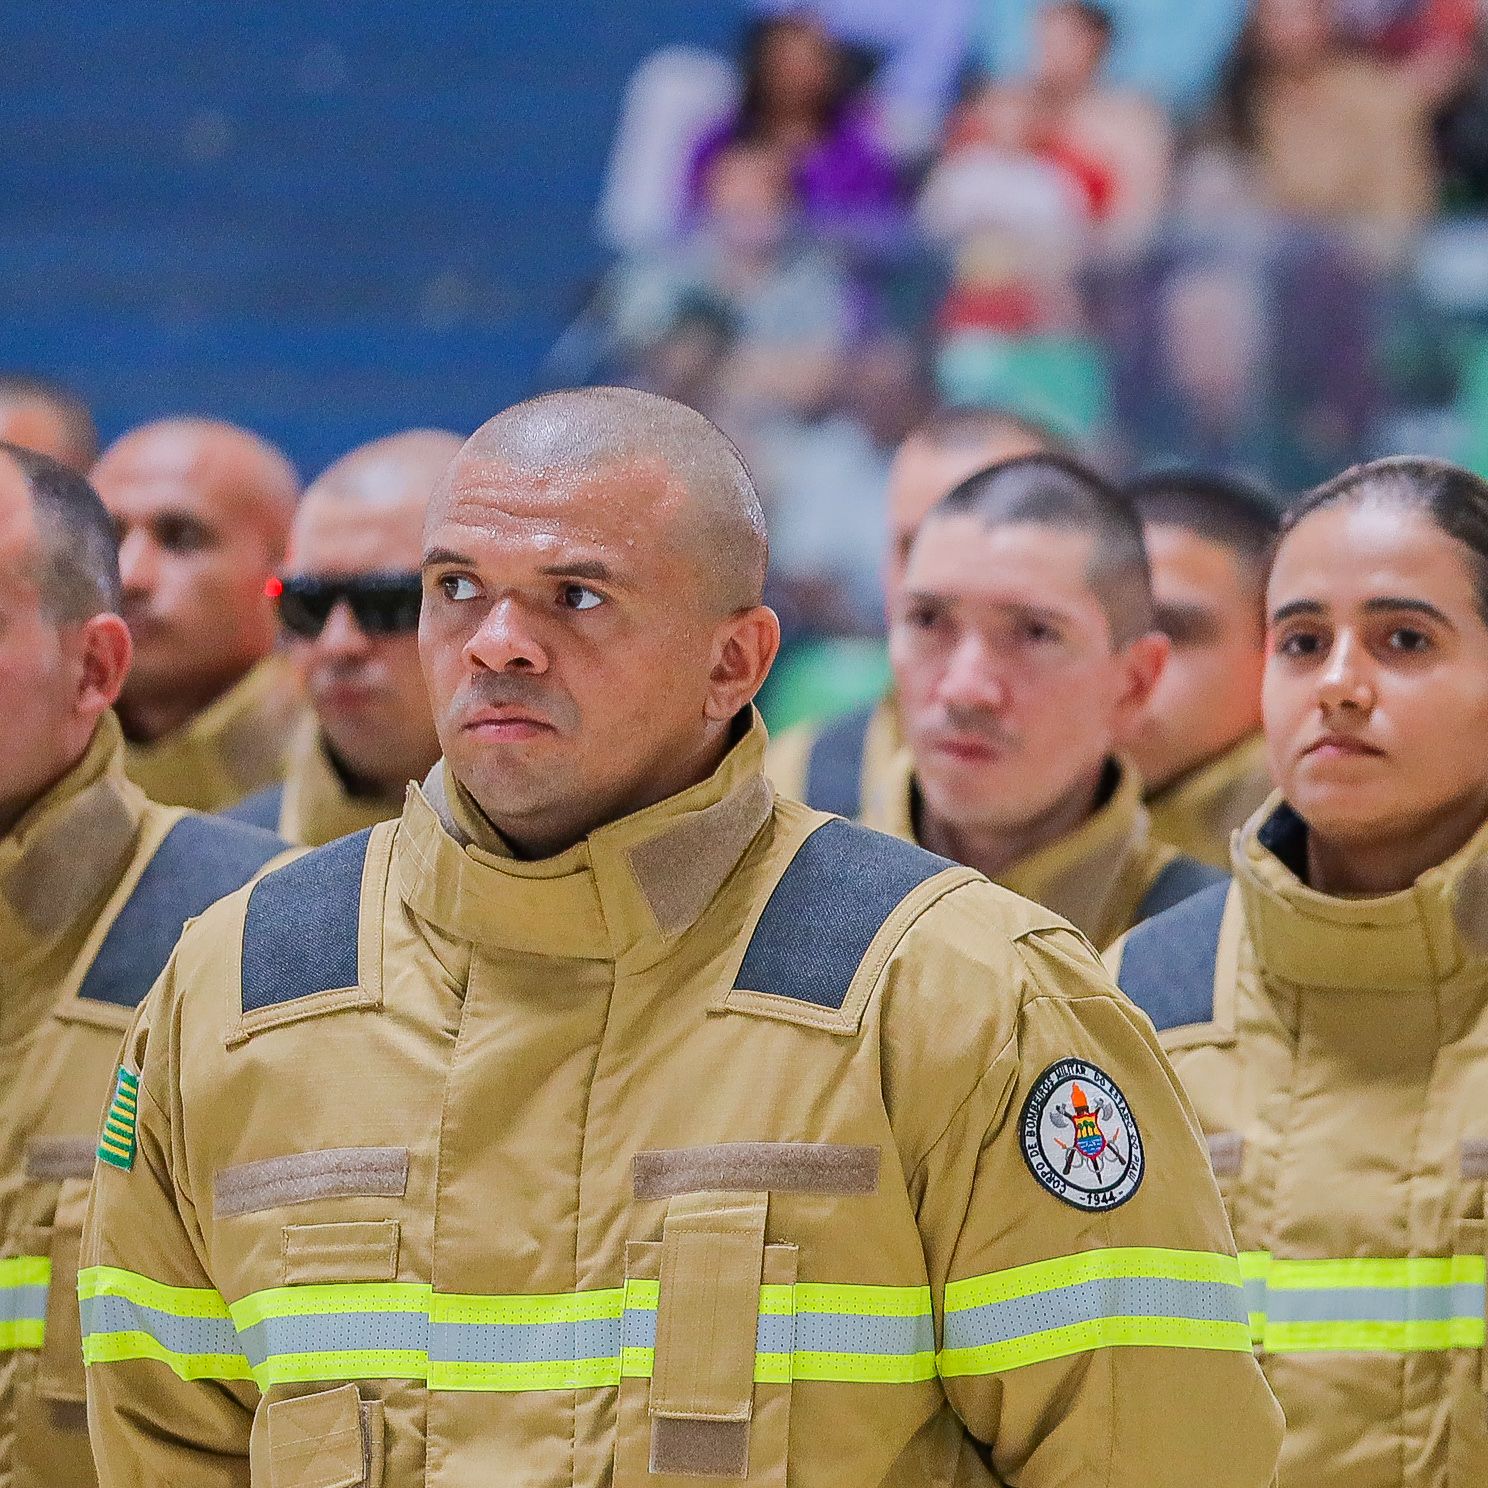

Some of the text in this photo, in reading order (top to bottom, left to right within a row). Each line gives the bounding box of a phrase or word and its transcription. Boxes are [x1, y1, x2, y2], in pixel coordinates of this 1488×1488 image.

[1054, 1064, 1087, 1079] MILITAR
[1094, 1071, 1106, 1086] DO
[1025, 1075, 1056, 1137] BOMBEIROS
[1131, 1133, 1139, 1150] DO
[1027, 1143, 1041, 1158] DE
[1036, 1161, 1067, 1194] CORPO
